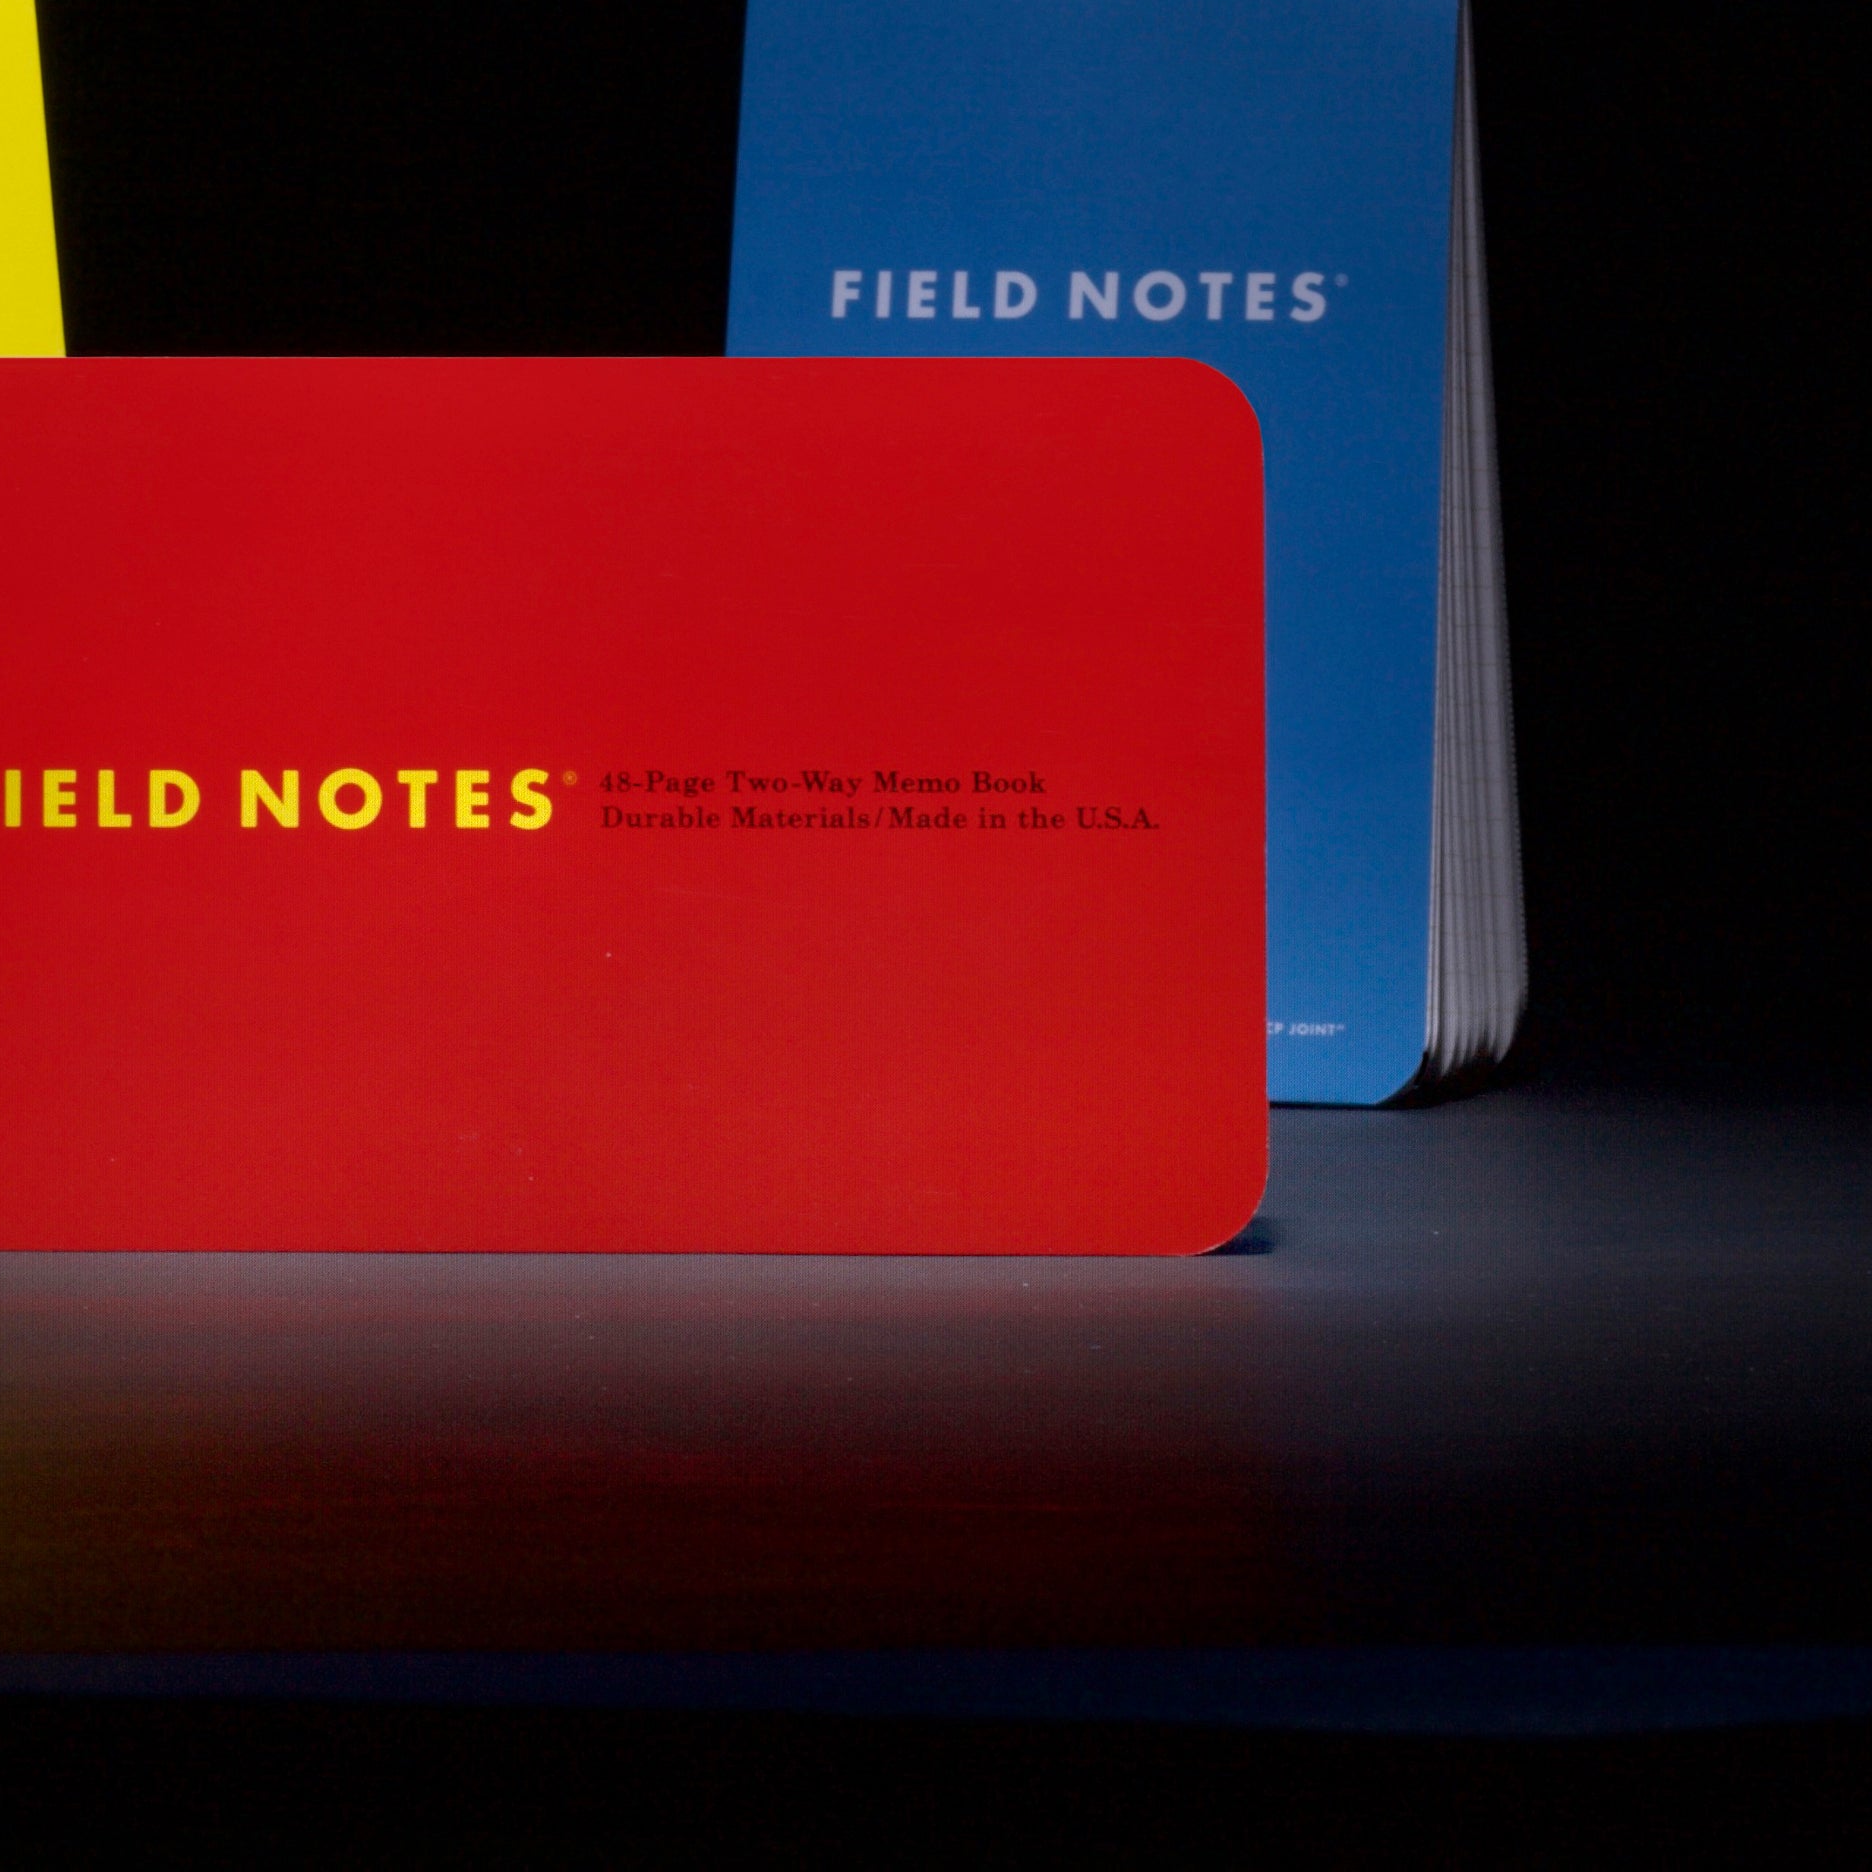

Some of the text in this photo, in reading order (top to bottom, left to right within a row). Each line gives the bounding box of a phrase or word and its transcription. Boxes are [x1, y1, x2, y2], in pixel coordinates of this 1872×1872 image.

[831, 270, 1037, 319] FIELD
[599, 770, 1047, 798] 48-Page Two-Way Memo Book
[602, 805, 721, 829] Durable
[979, 807, 1006, 829] in
[1018, 807, 1065, 829] the
[1076, 806, 1160, 829] U.S.A.
